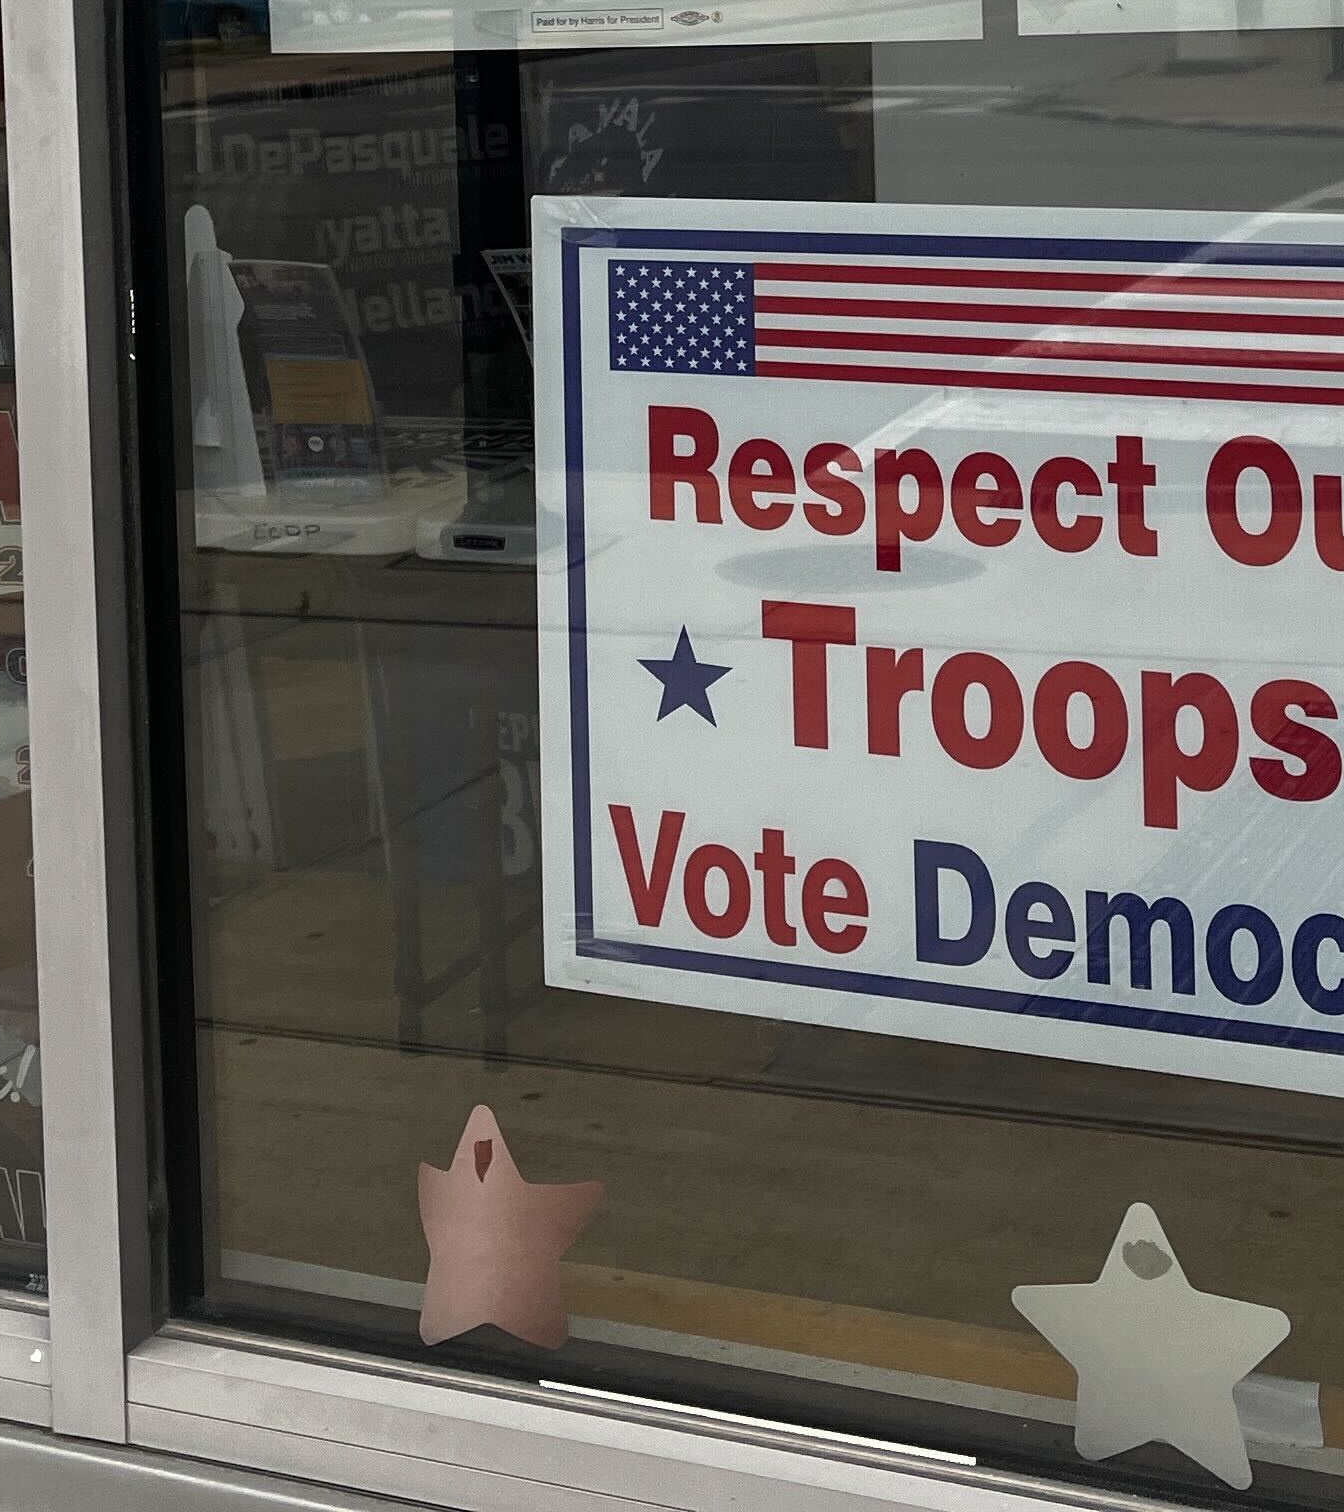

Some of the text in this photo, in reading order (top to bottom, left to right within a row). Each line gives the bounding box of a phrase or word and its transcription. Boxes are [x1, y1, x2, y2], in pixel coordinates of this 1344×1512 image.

[536, 17, 555, 26] Paid
[569, 17, 578, 27] by
[581, 15, 605, 25] Harris
[607, 15, 617, 25] for
[620, 14, 660, 25] President
[647, 404, 1159, 573] Respect
[761, 600, 1343, 830] Troops
[607, 804, 869, 954] Vote
